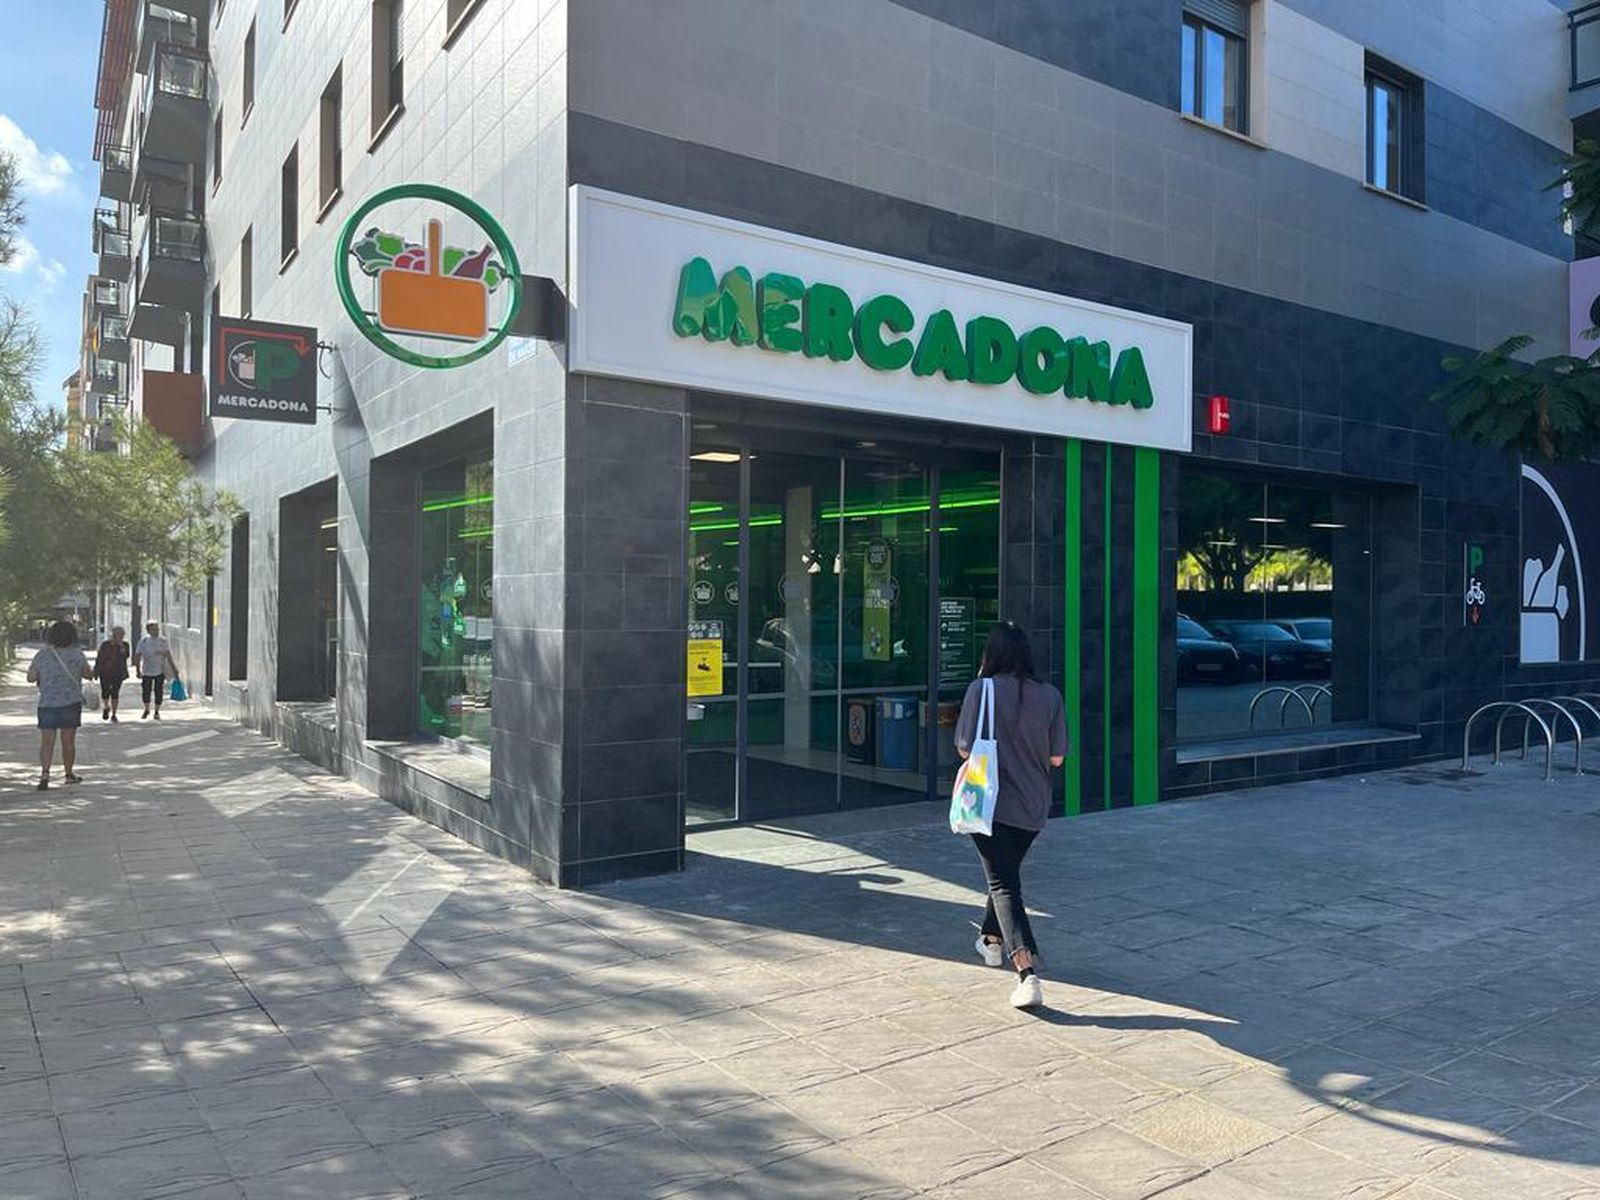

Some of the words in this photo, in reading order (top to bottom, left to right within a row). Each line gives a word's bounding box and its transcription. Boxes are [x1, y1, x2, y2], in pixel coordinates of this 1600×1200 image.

[673, 256, 1153, 409] MERCADONA
[217, 394, 309, 412] MERCADONA
[1470, 546, 1483, 574] P
